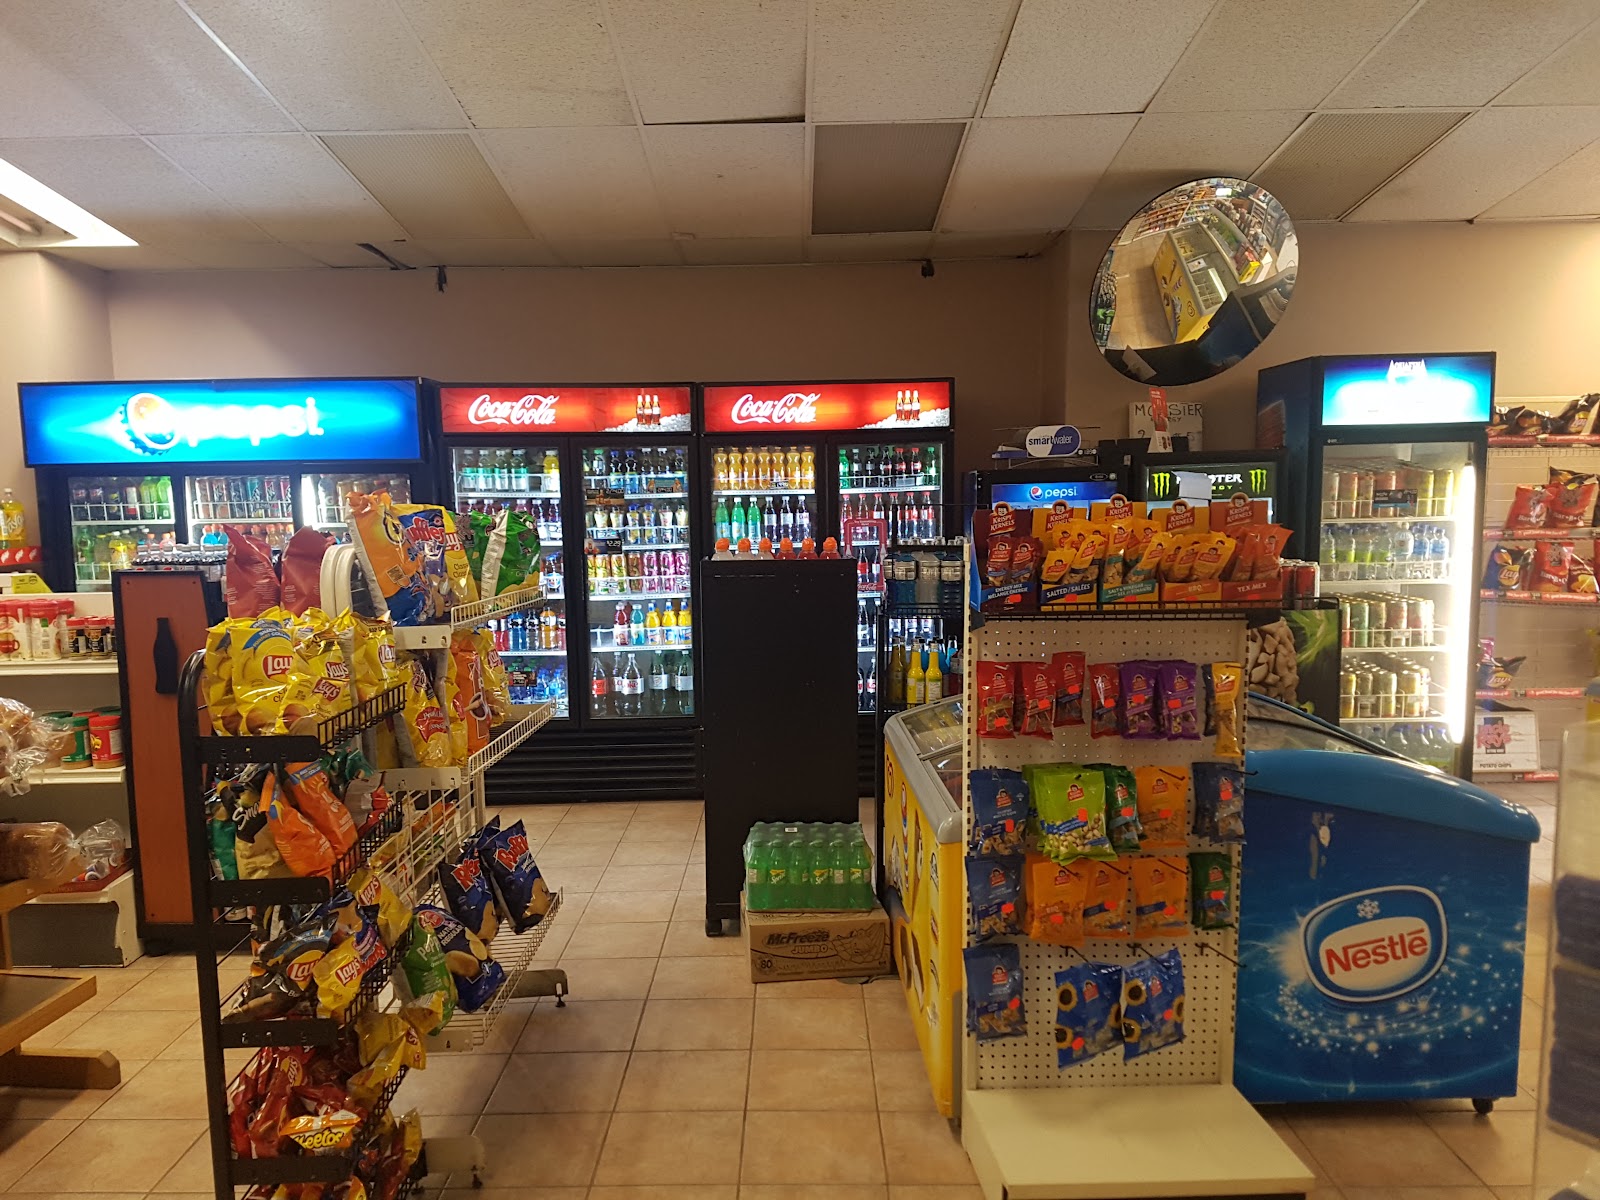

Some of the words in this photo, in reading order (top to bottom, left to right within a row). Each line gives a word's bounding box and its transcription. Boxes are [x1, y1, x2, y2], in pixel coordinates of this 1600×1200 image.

[467, 394, 560, 426] Coca-Cola
[731, 392, 821, 425] Coca-Cola
[1028, 434, 1073, 446] smartwater
[1044, 486, 1078, 499] pepsi
[1109, 506, 1129, 516] KRISPY
[1229, 505, 1250, 516] KRISPY
[992, 514, 1013, 524] KRISPY
[1049, 513, 1069, 522] KRISPY
[1170, 513, 1192, 523] KRISPY
[1226, 511, 1253, 523] KERNELS
[990, 520, 1016, 532] KERNELS
[1167, 518, 1194, 530] KERNELS
[1046, 588, 1068, 598] SALTED
[1237, 585, 1250, 593] TEX
[1252, 582, 1267, 590] MEX
[314, 679, 341, 699] Lay's
[359, 875, 380, 905] Lay's
[766, 930, 830, 946] McFreeze
[791, 944, 829, 955] JUMBO
[1324, 928, 1428, 976] Nestlé
[760, 960, 773, 969] 80
[336, 958, 361, 984] Lay's
